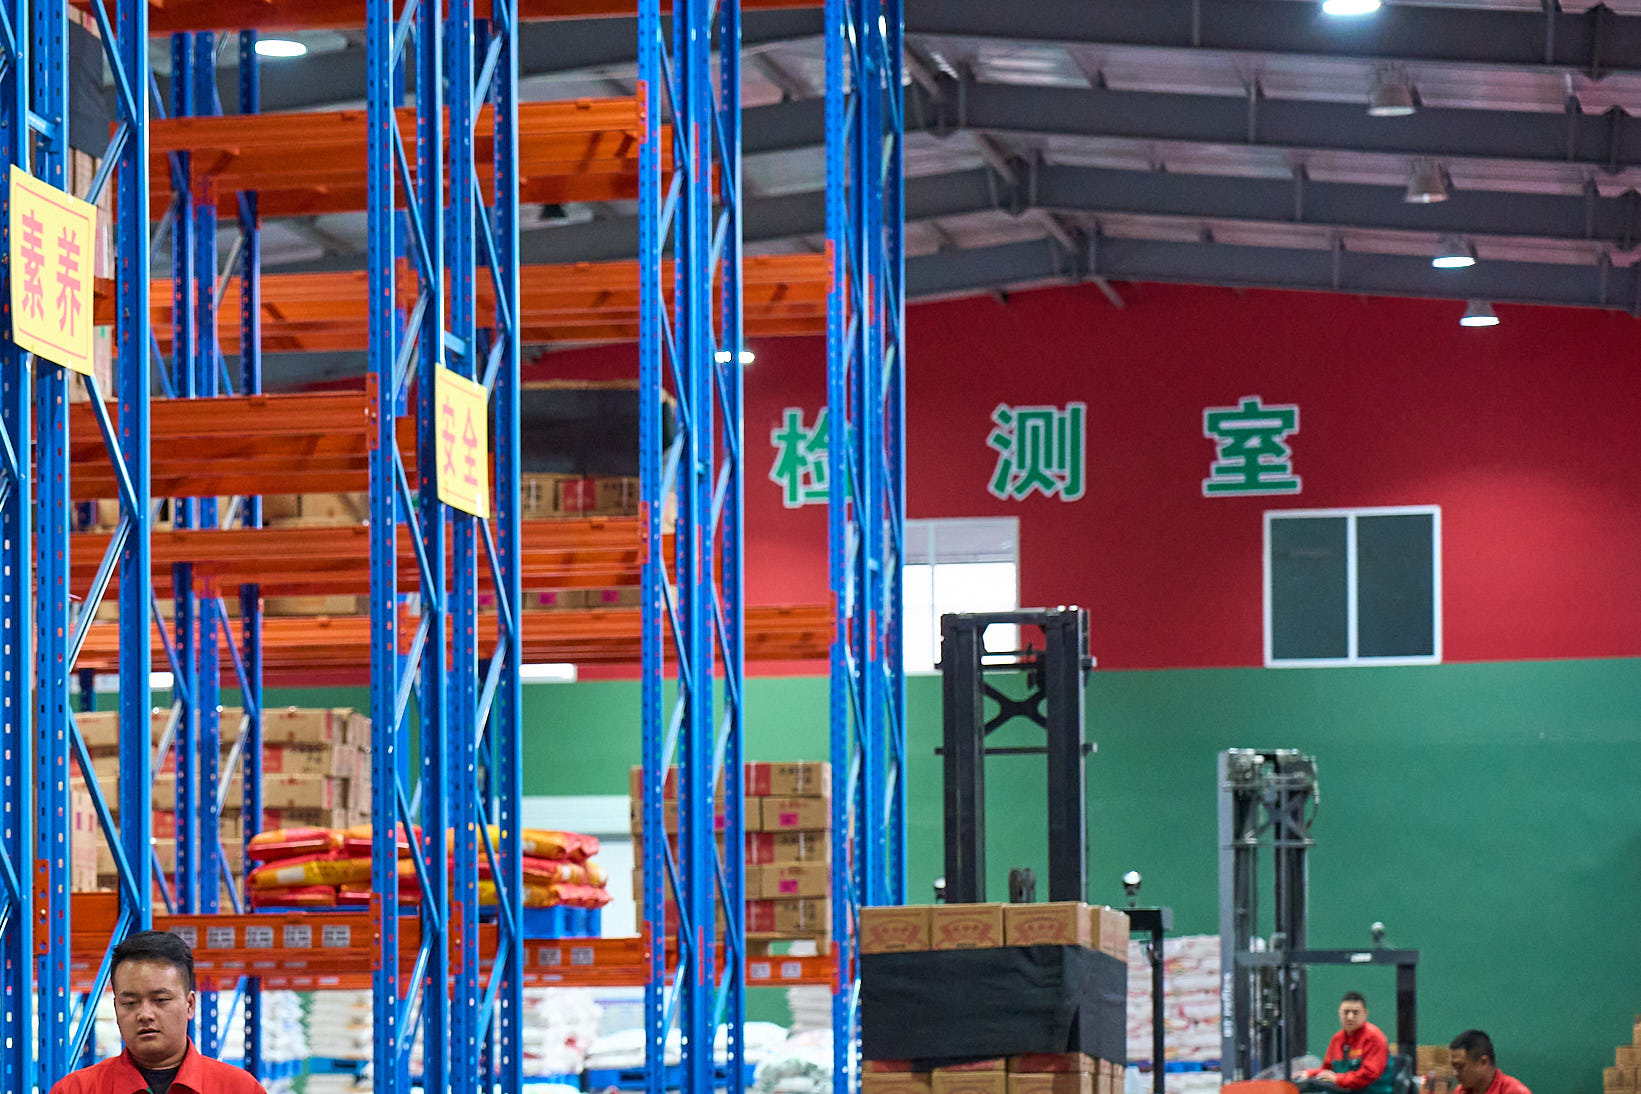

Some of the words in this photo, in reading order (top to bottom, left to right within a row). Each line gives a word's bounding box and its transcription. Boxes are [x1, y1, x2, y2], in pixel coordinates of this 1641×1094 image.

[21, 210, 81, 337] 素养
[441, 395, 478, 487] 安全
[770, 396, 1302, 509] 检测室
